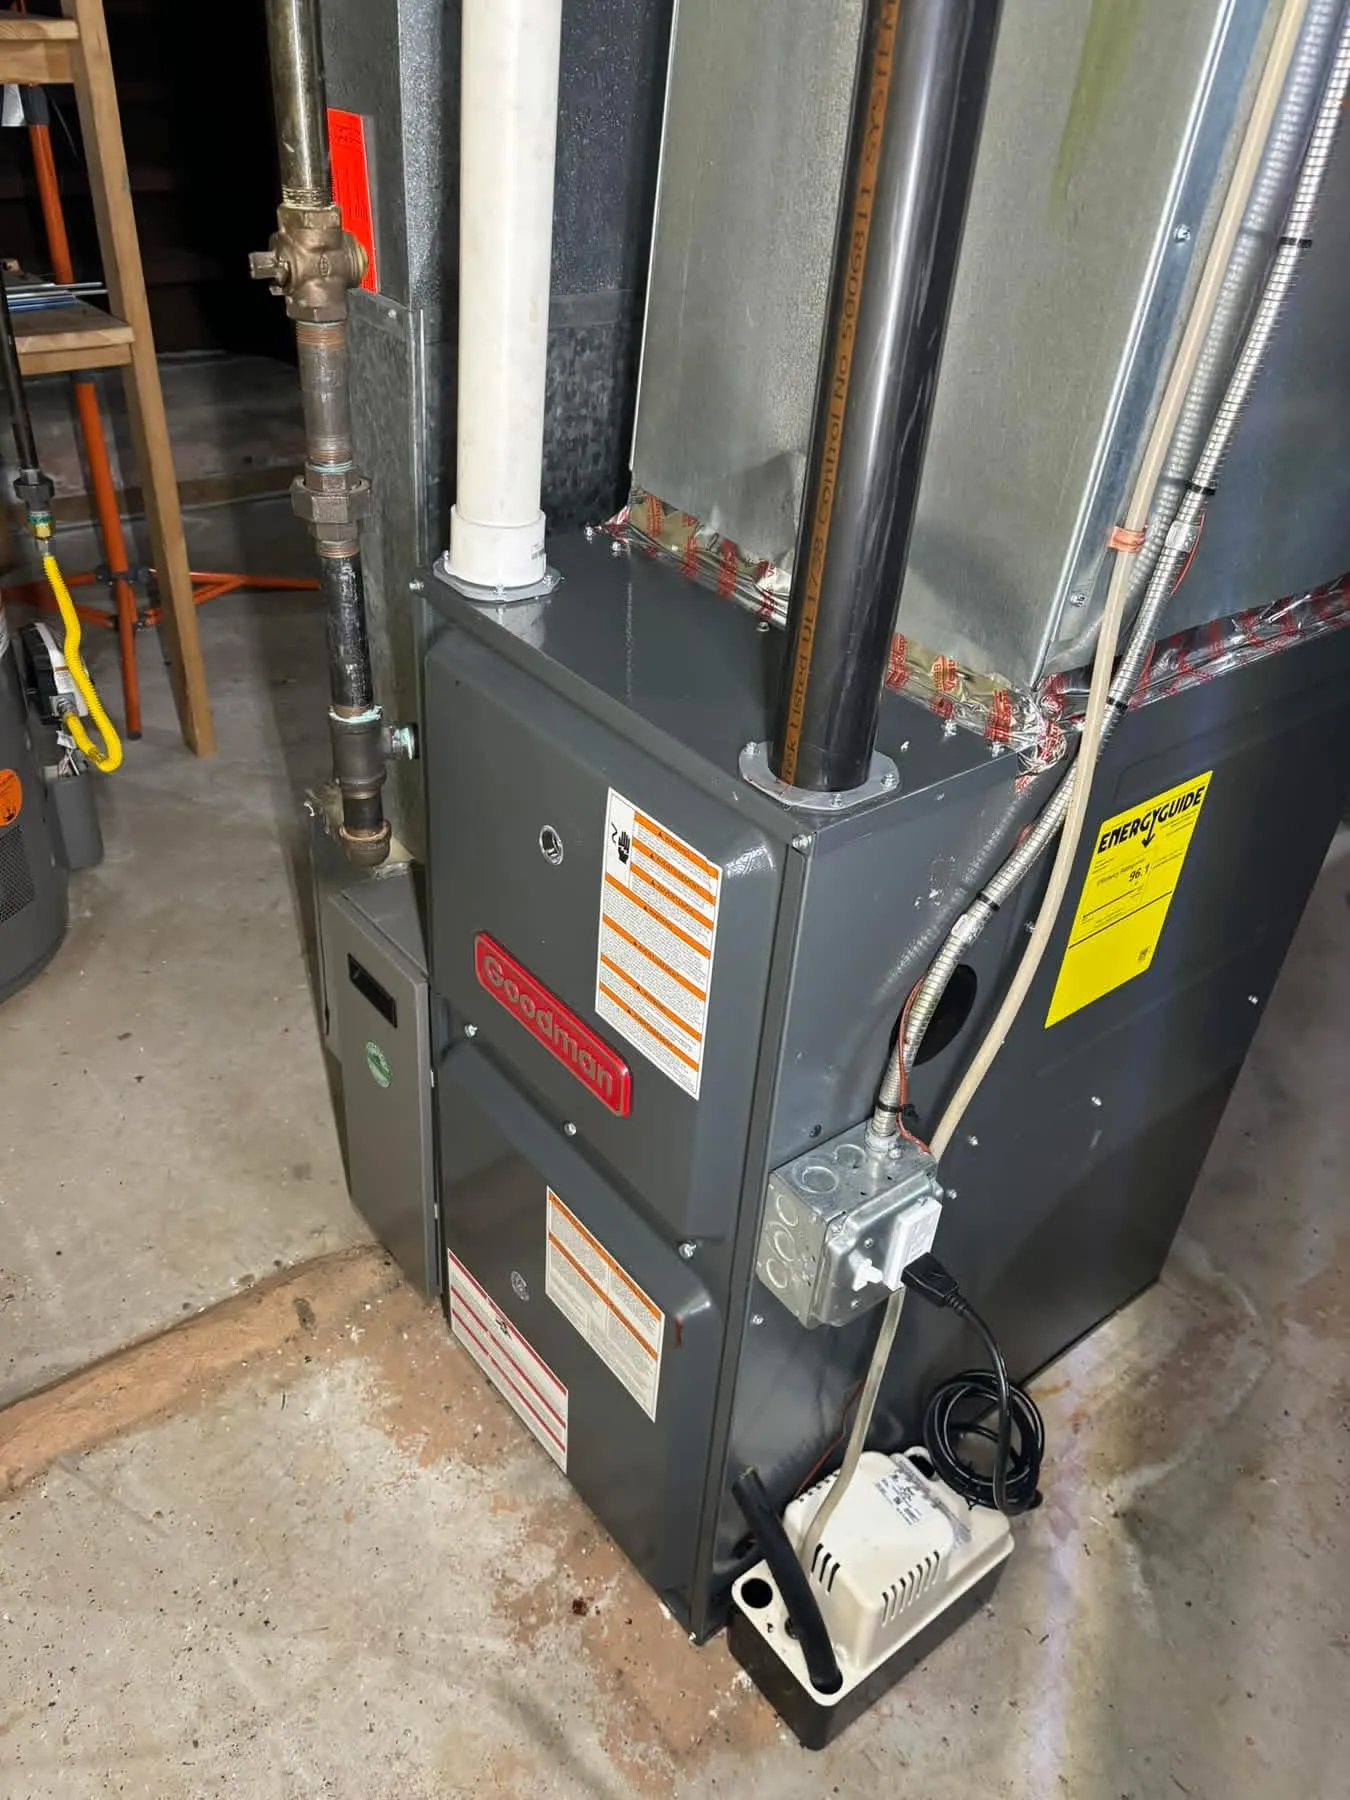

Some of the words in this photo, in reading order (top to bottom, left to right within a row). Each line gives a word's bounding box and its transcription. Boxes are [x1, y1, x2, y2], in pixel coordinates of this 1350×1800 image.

[818, 412, 842, 525] Control
[1098, 786, 1206, 853] ENERGYGUIDE
[1128, 863, 1150, 882] 96.1
[482, 954, 614, 1098] Goodman
